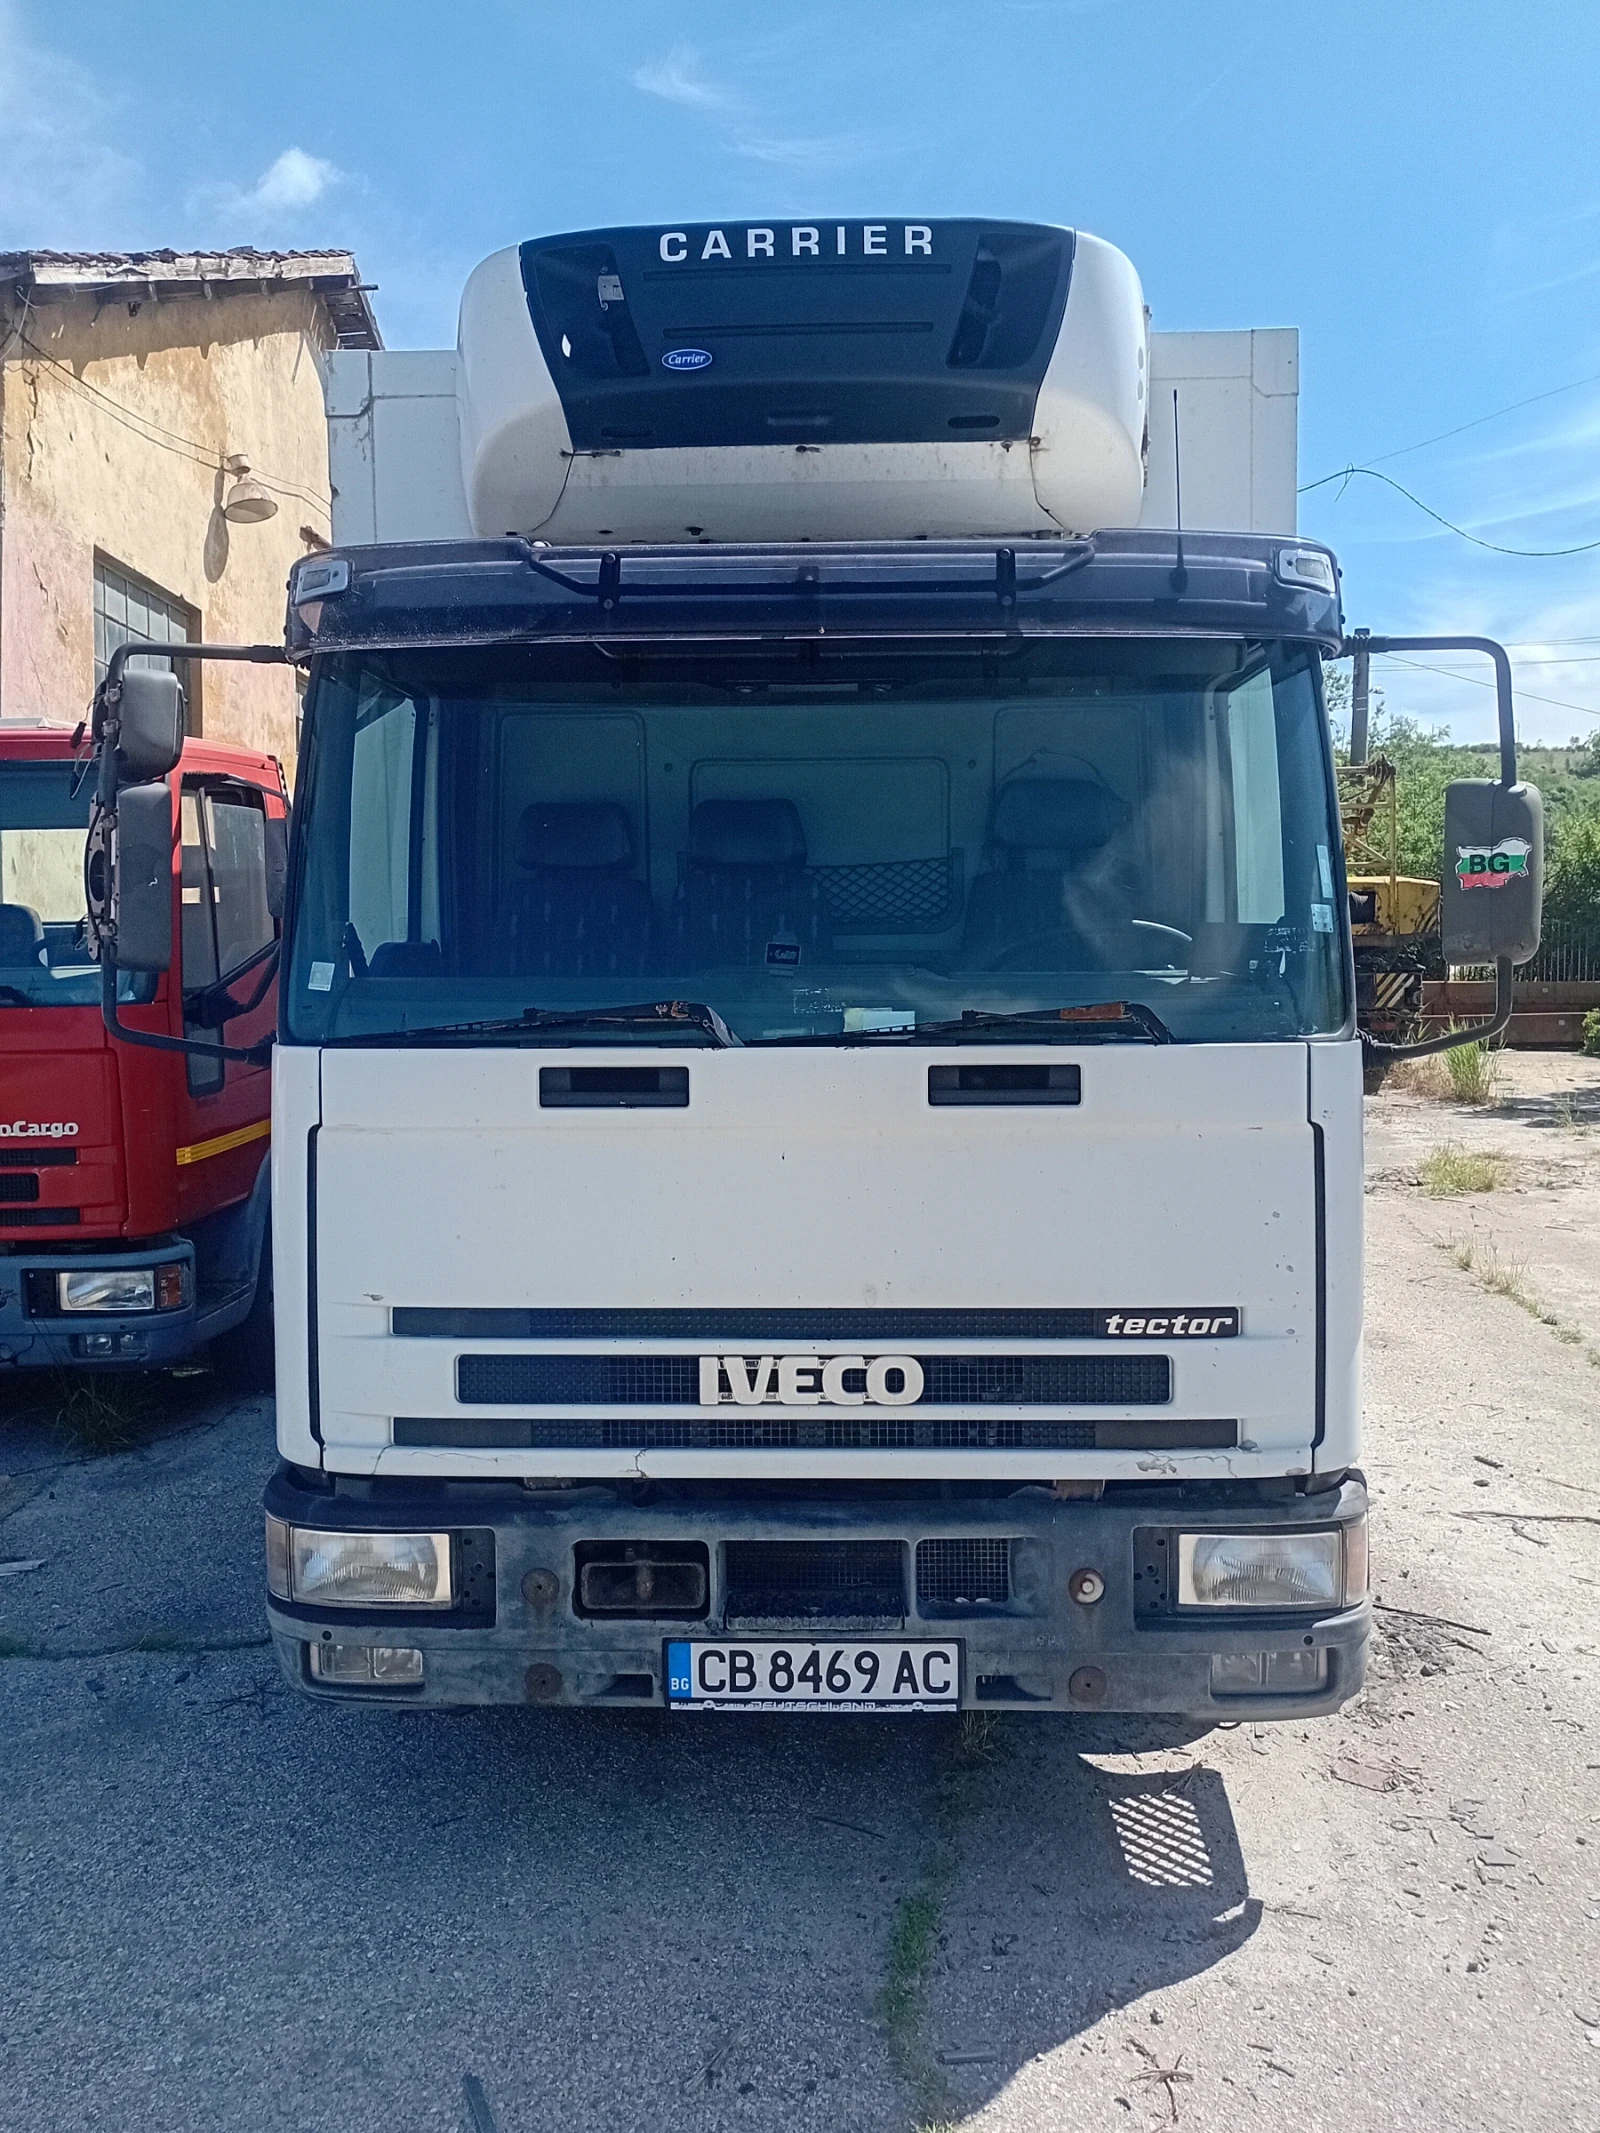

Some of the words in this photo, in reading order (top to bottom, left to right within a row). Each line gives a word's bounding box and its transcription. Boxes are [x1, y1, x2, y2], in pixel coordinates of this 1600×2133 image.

[659, 225, 934, 262] CARRIER
[667, 352, 706, 366] Carrier
[1469, 852, 1510, 874] BG
[0, 1120, 79, 1138] oCargo
[1105, 1314, 1233, 1336] tector
[699, 1355, 925, 1406] IVECO
[698, 1650, 757, 1694] CB
[769, 1650, 880, 1694] 8469
[892, 1650, 951, 1694] AC
[671, 1678, 690, 1691] BG
